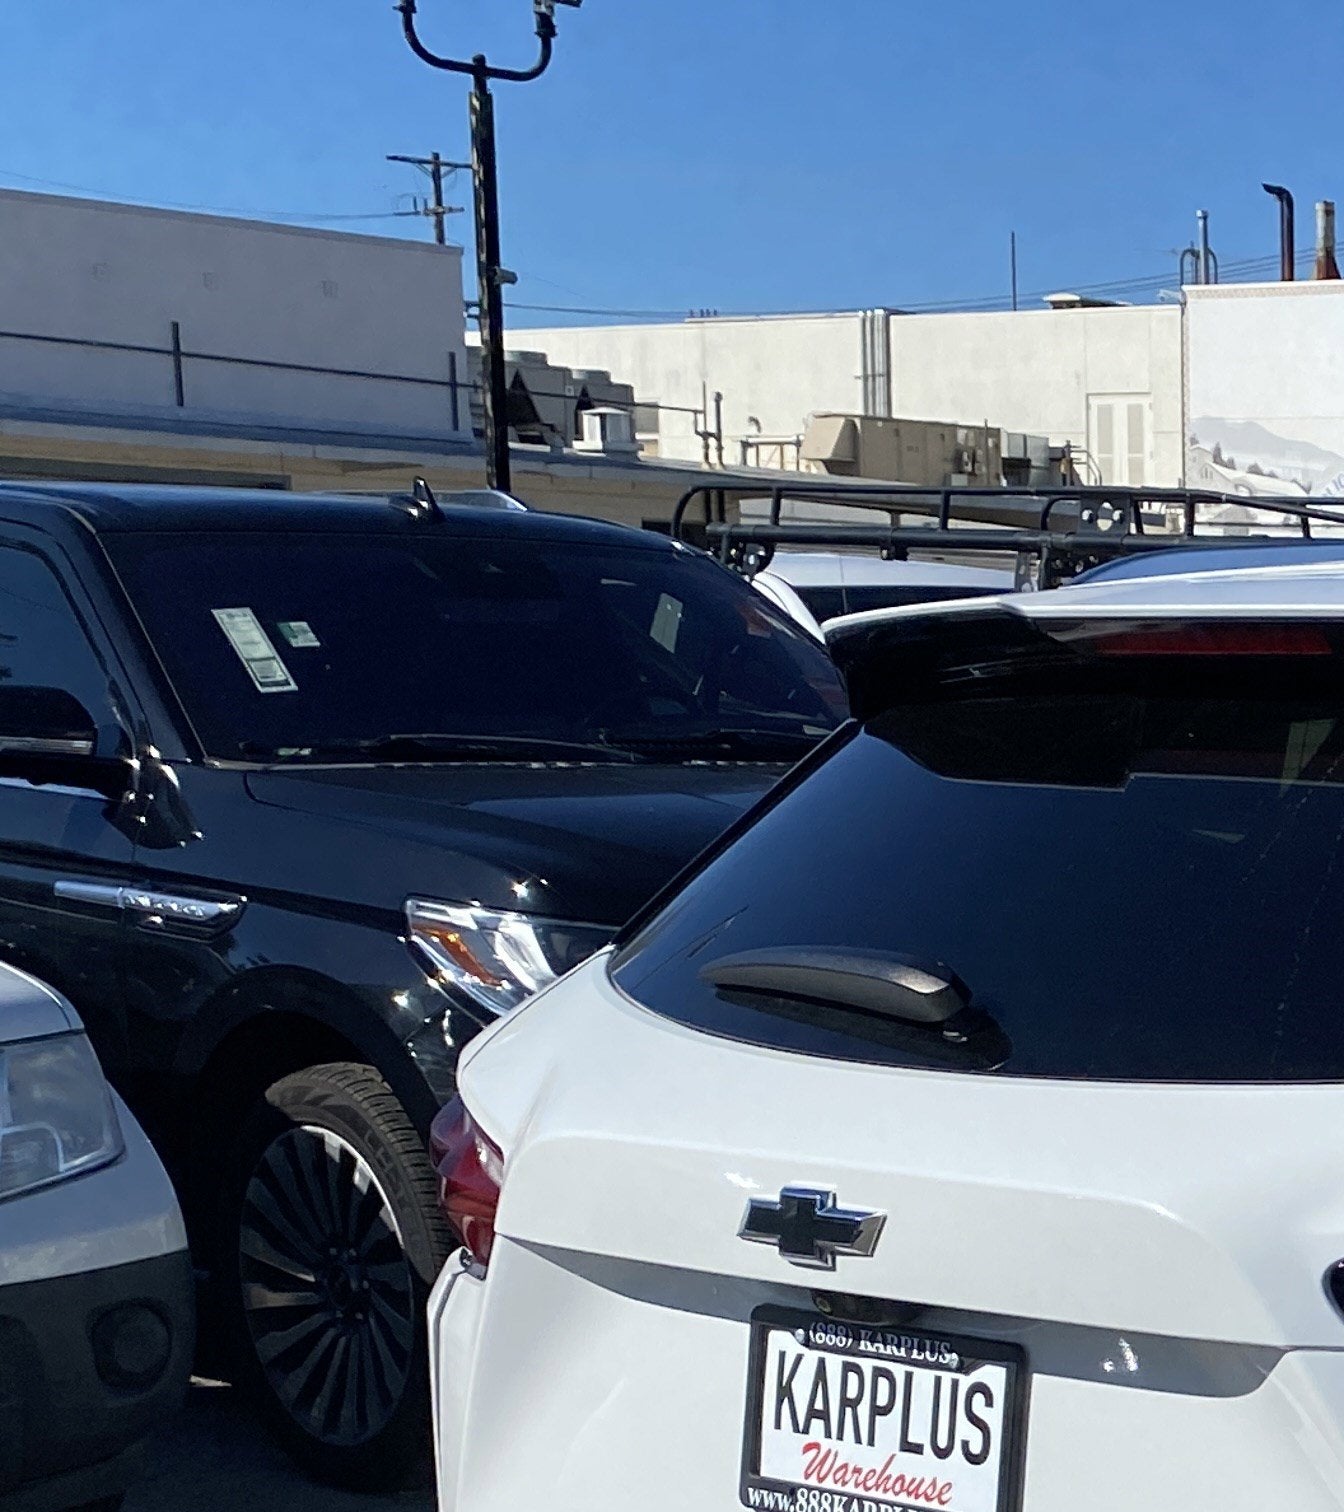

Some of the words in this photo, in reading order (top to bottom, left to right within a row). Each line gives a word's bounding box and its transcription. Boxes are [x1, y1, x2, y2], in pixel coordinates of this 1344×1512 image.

[808, 1321, 854, 1349] (888)
[858, 1329, 952, 1365] KARPLUS
[773, 1349, 995, 1466] KARPLUS
[801, 1441, 954, 1506] Warehouse
